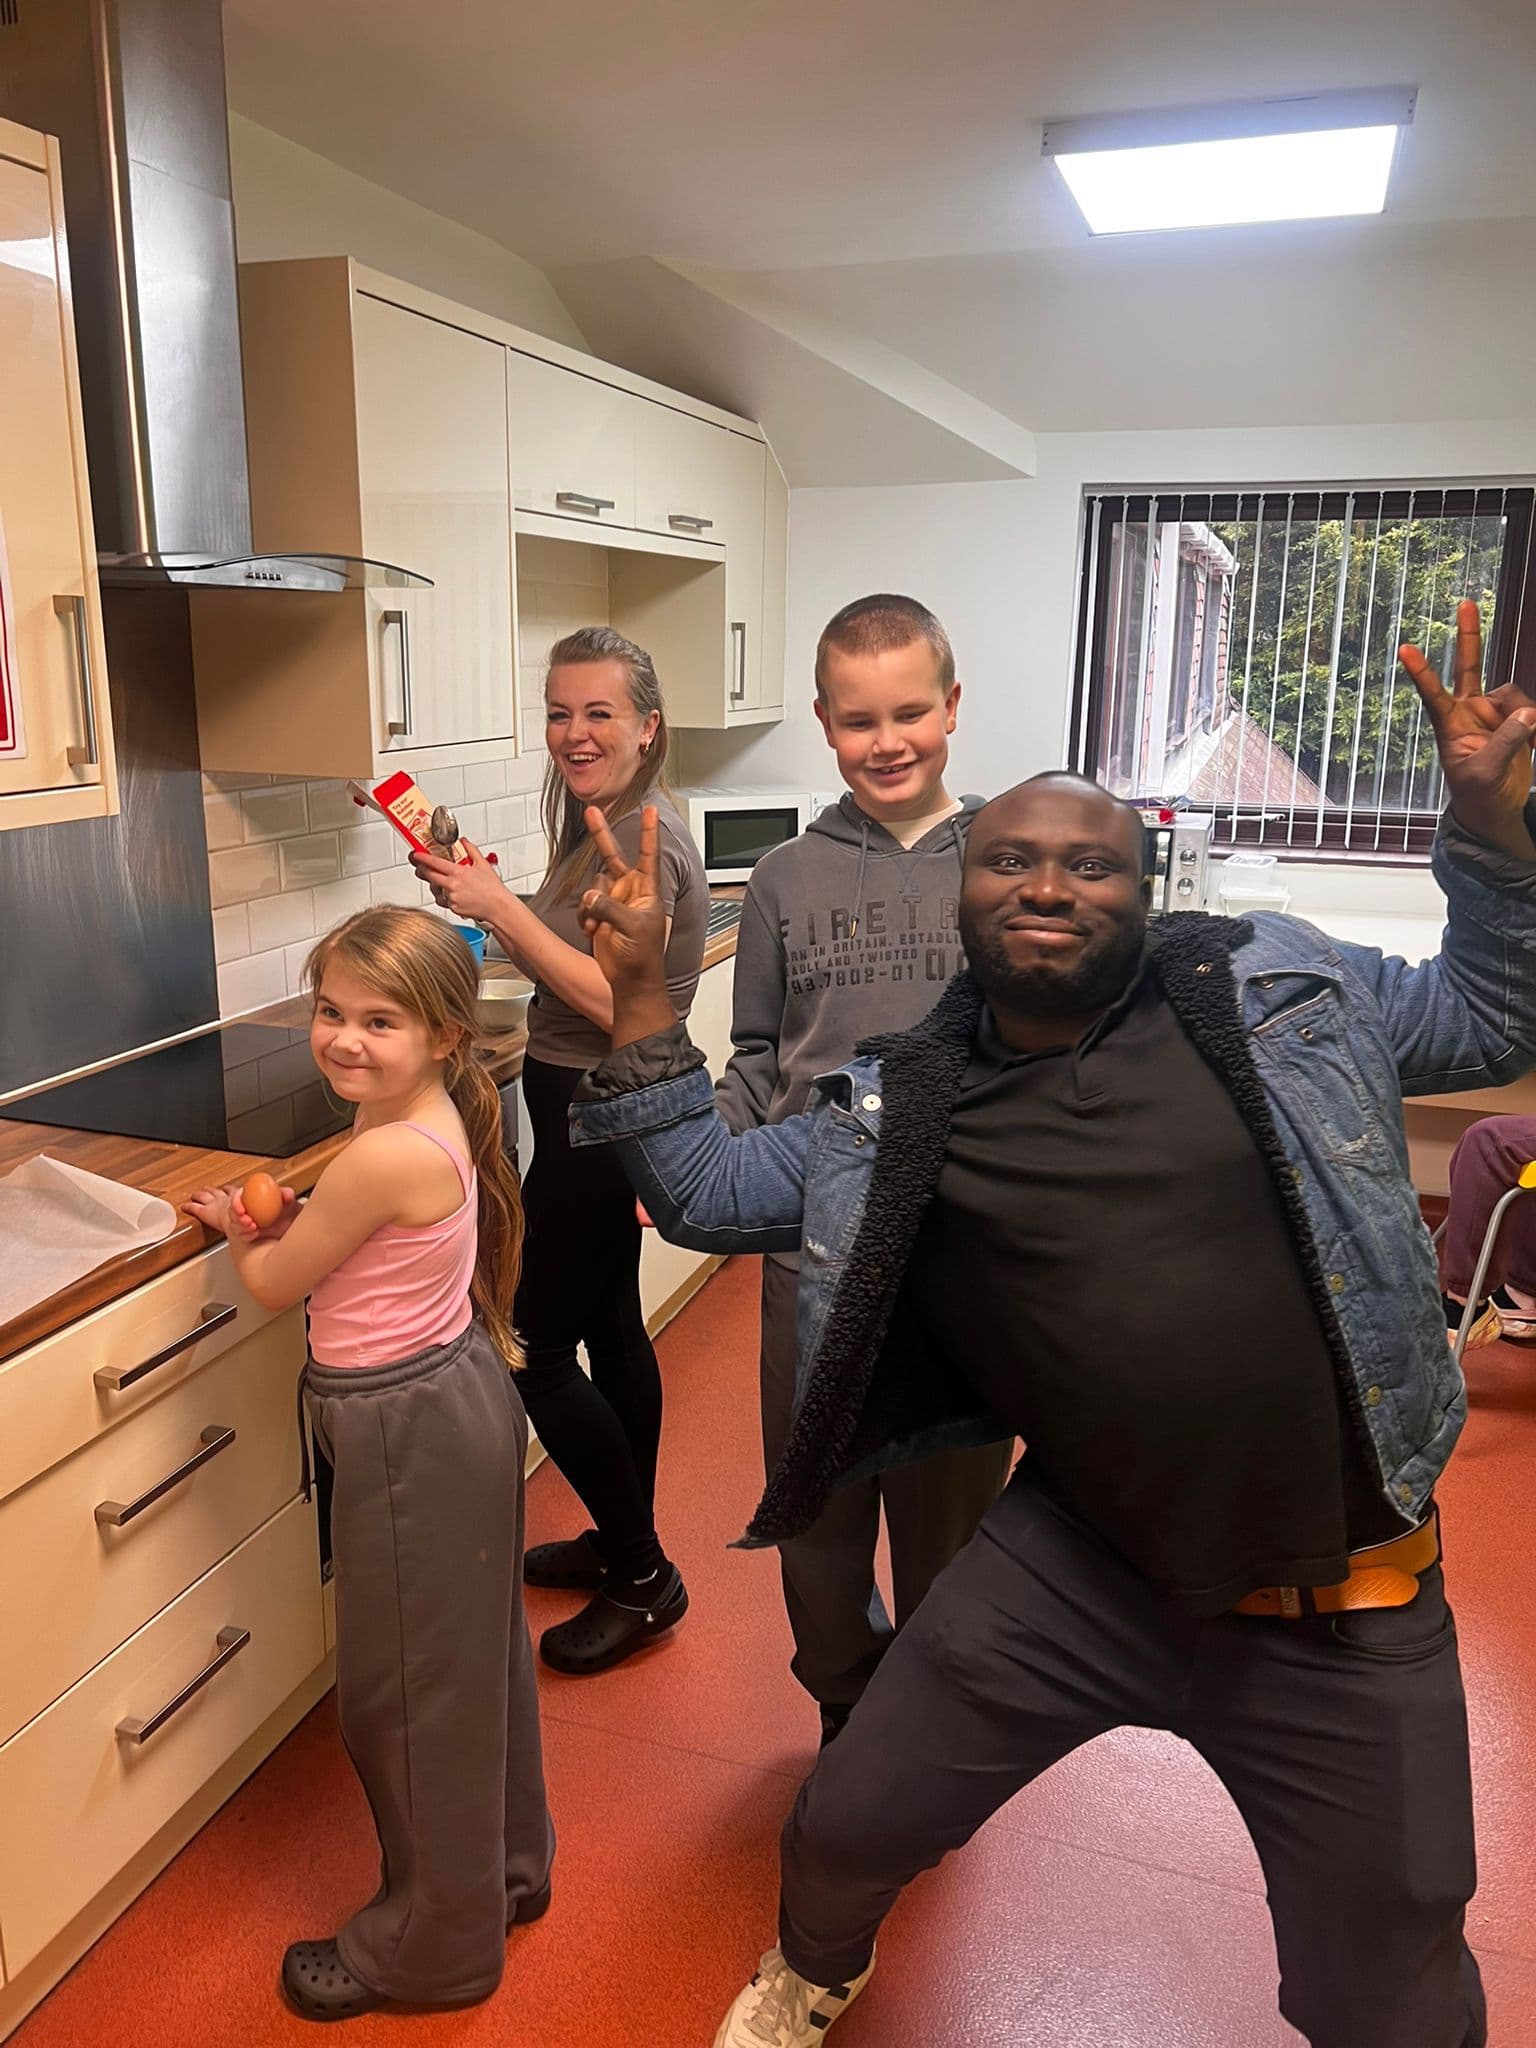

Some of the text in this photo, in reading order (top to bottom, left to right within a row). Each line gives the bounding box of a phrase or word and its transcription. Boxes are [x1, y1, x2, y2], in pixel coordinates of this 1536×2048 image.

[780, 895, 959, 946] FIRETR
[814, 945, 826, 958] IN
[900, 931, 959, 945] ESTABLI
[827, 953, 850, 968] AND
[859, 948, 918, 965] TWISTED
